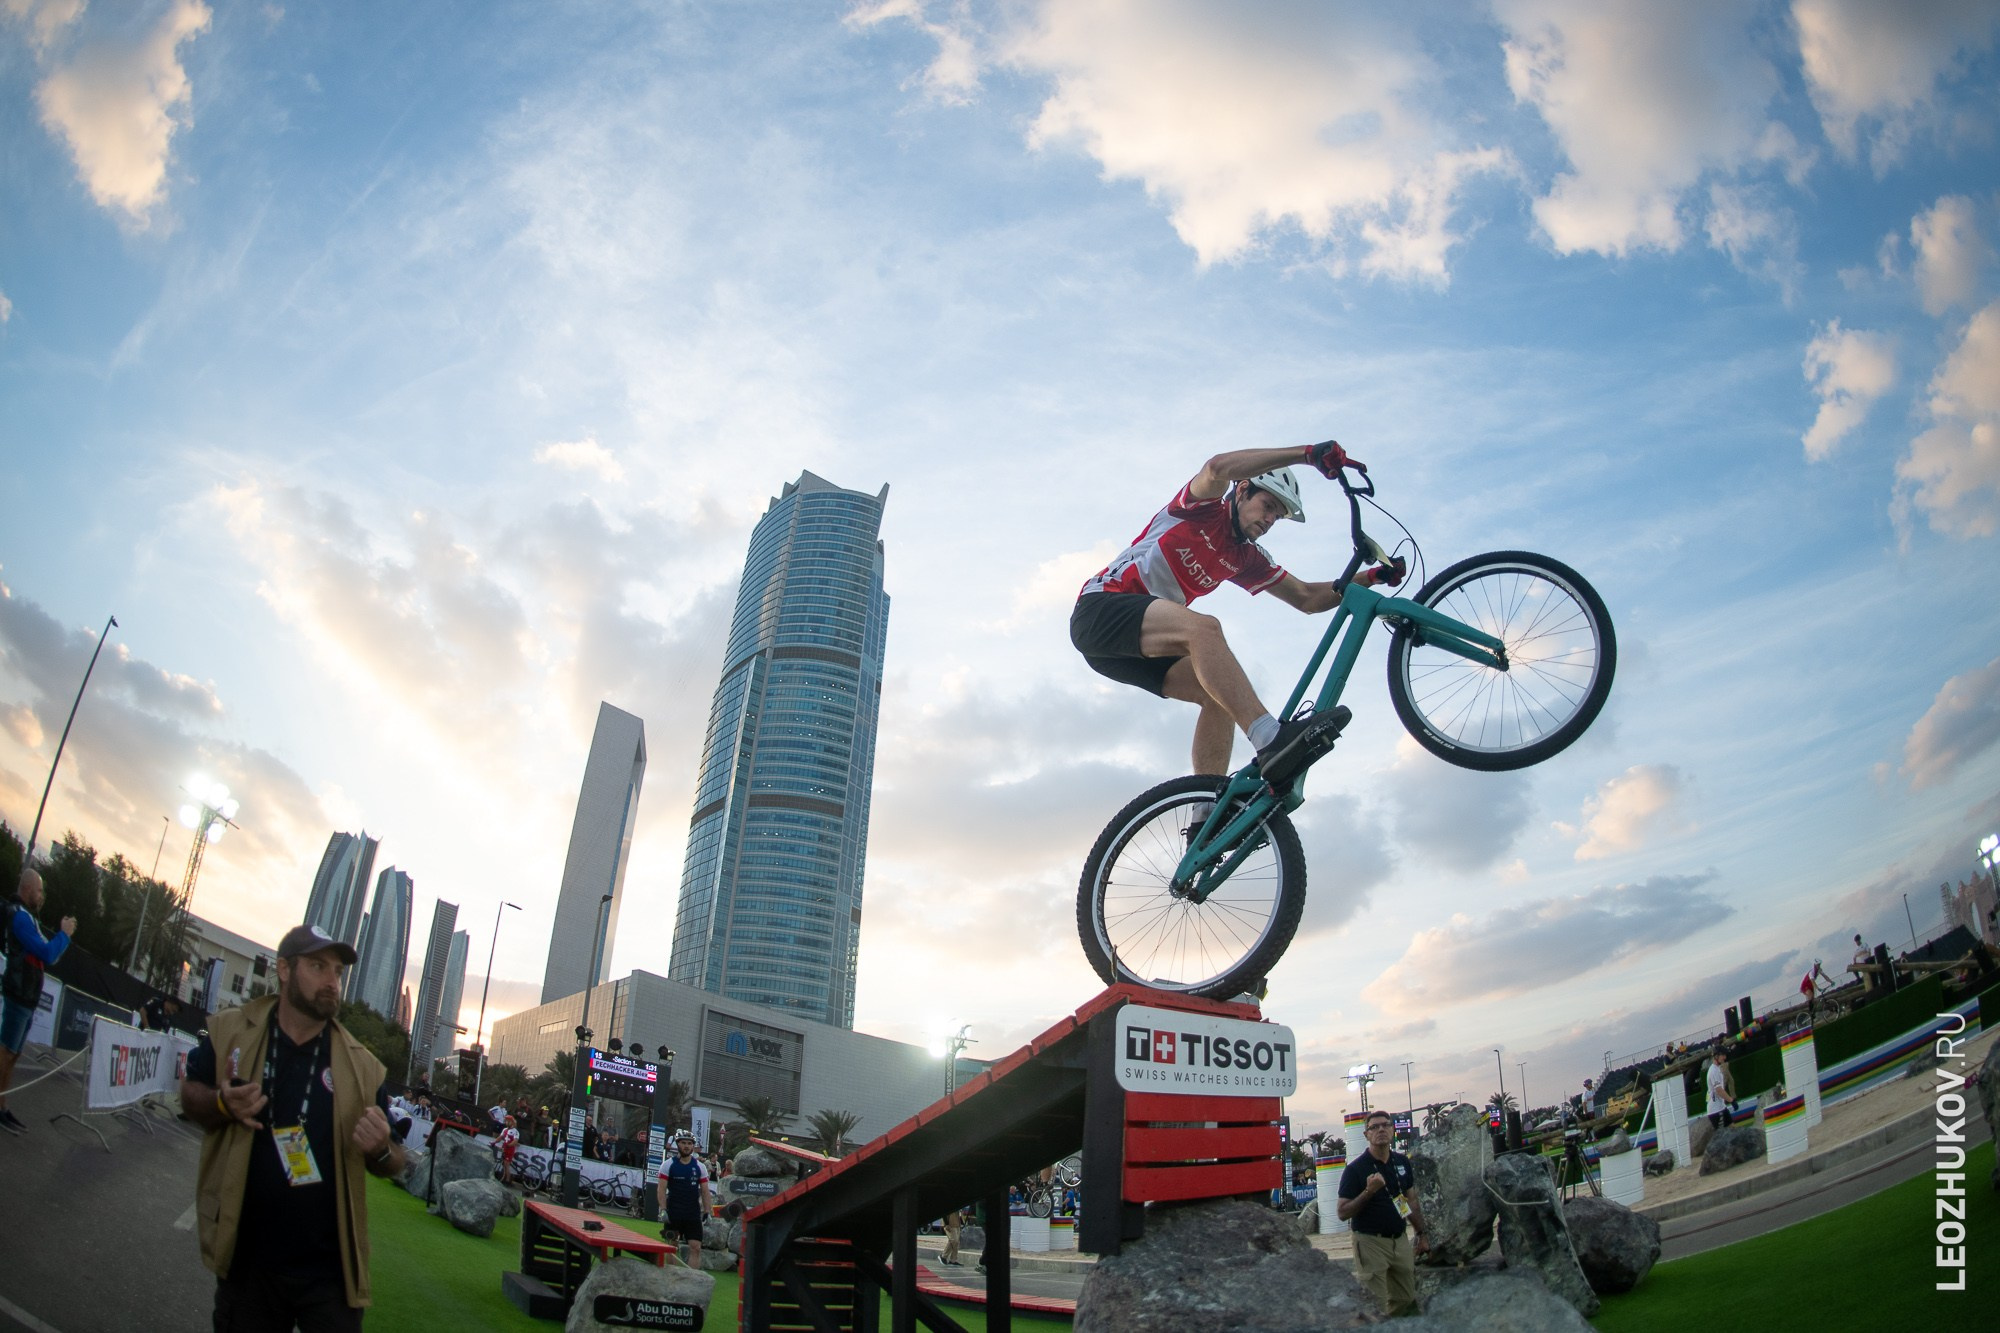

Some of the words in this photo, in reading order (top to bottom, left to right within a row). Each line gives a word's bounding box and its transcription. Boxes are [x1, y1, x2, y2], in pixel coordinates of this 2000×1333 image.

[750, 1036, 783, 1059] VOX
[1181, 1033, 1290, 1072] TISSOT
[595, 1052, 603, 1060] 15
[129, 1045, 161, 1086] TISSOT
[595, 1061, 635, 1075] PECHHACKER
[1125, 1067, 1166, 1081] SWISS
[1174, 1072, 1229, 1085] WATCHES
[1234, 1076, 1266, 1087] SINCE
[645, 1084, 655, 1093] 10
[1053, 1196, 1060, 1207] 2
[637, 1303, 659, 1314] Abu
[661, 1305, 693, 1317] Dhabi
[636, 1312, 663, 1323] Sports
[664, 1315, 693, 1326] Council
